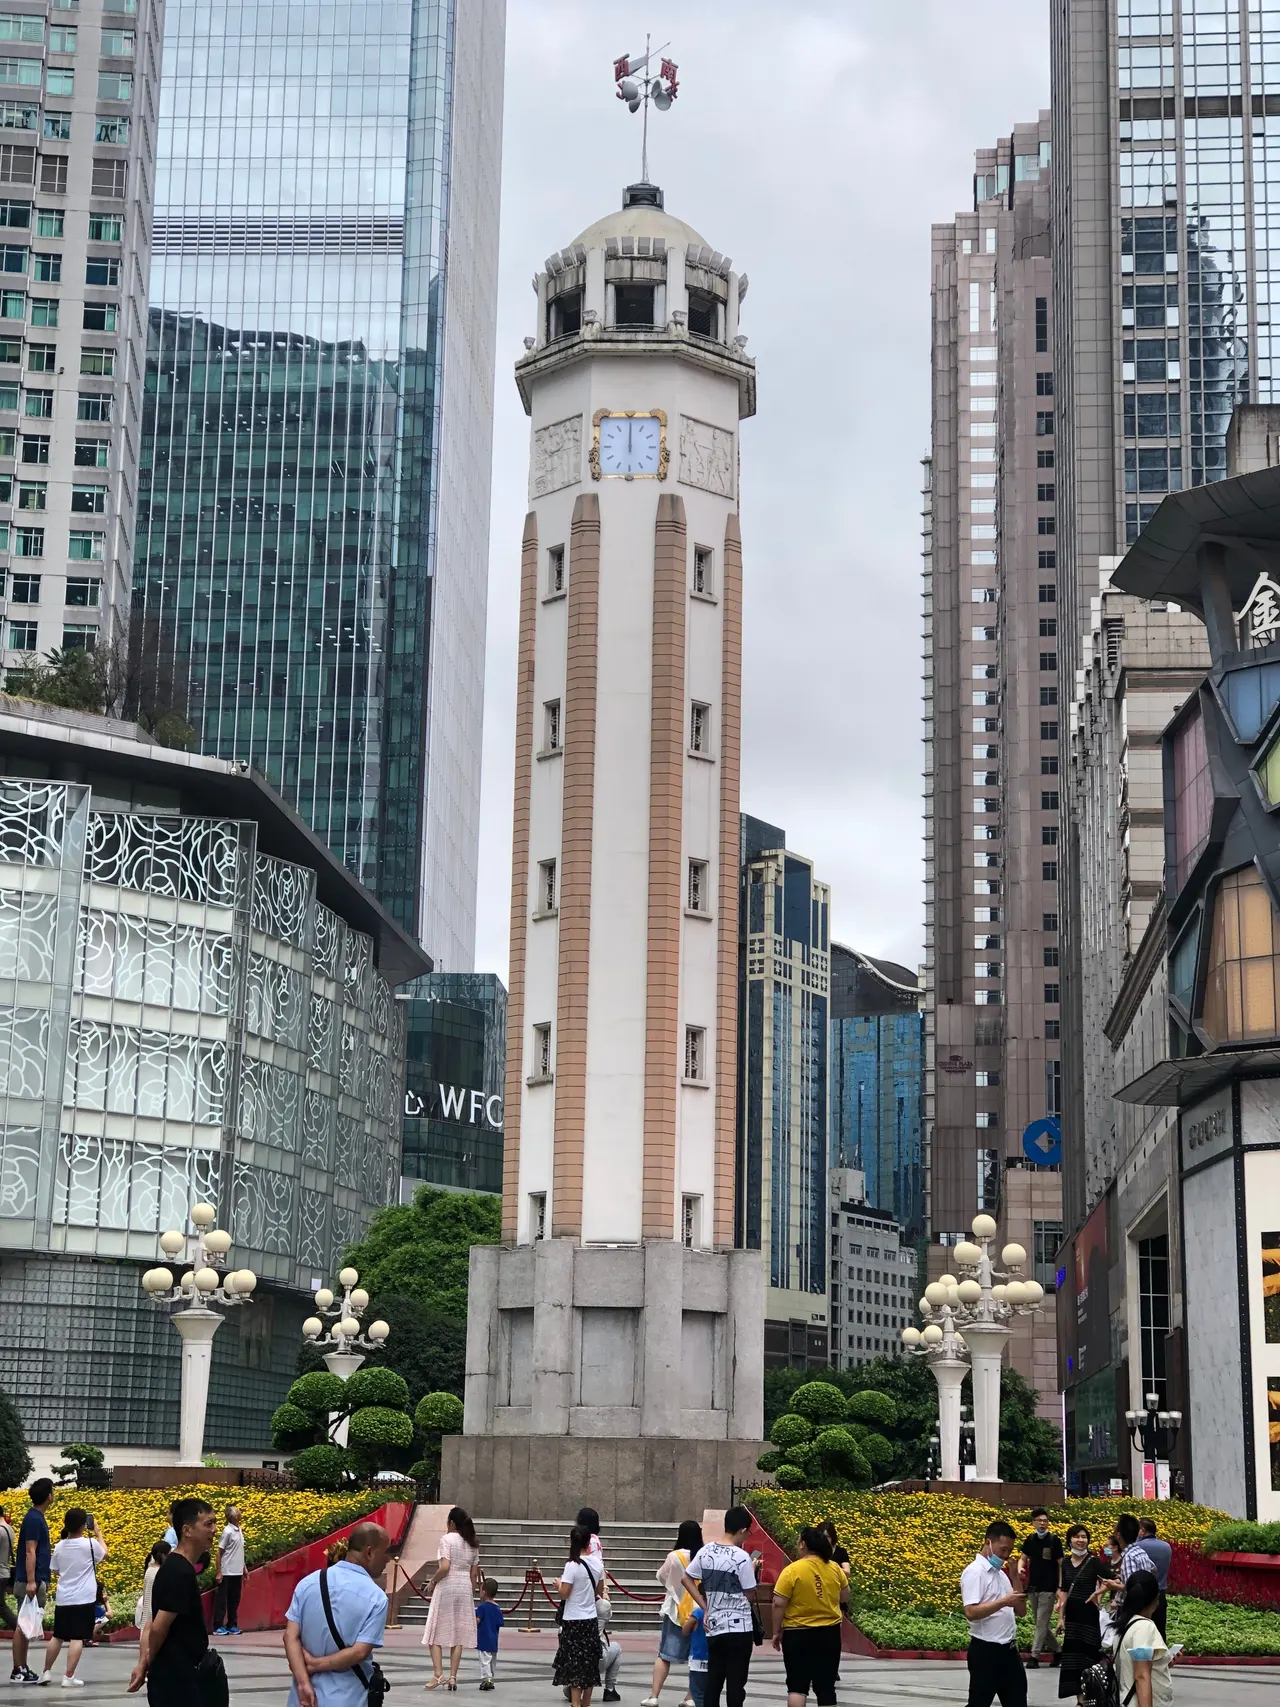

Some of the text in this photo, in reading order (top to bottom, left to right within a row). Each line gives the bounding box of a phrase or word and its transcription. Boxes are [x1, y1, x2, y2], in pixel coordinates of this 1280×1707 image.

[1236, 571, 1280, 637] 金
[439, 1083, 504, 1128] WFC
[1189, 1108, 1226, 1150] GUCCI
